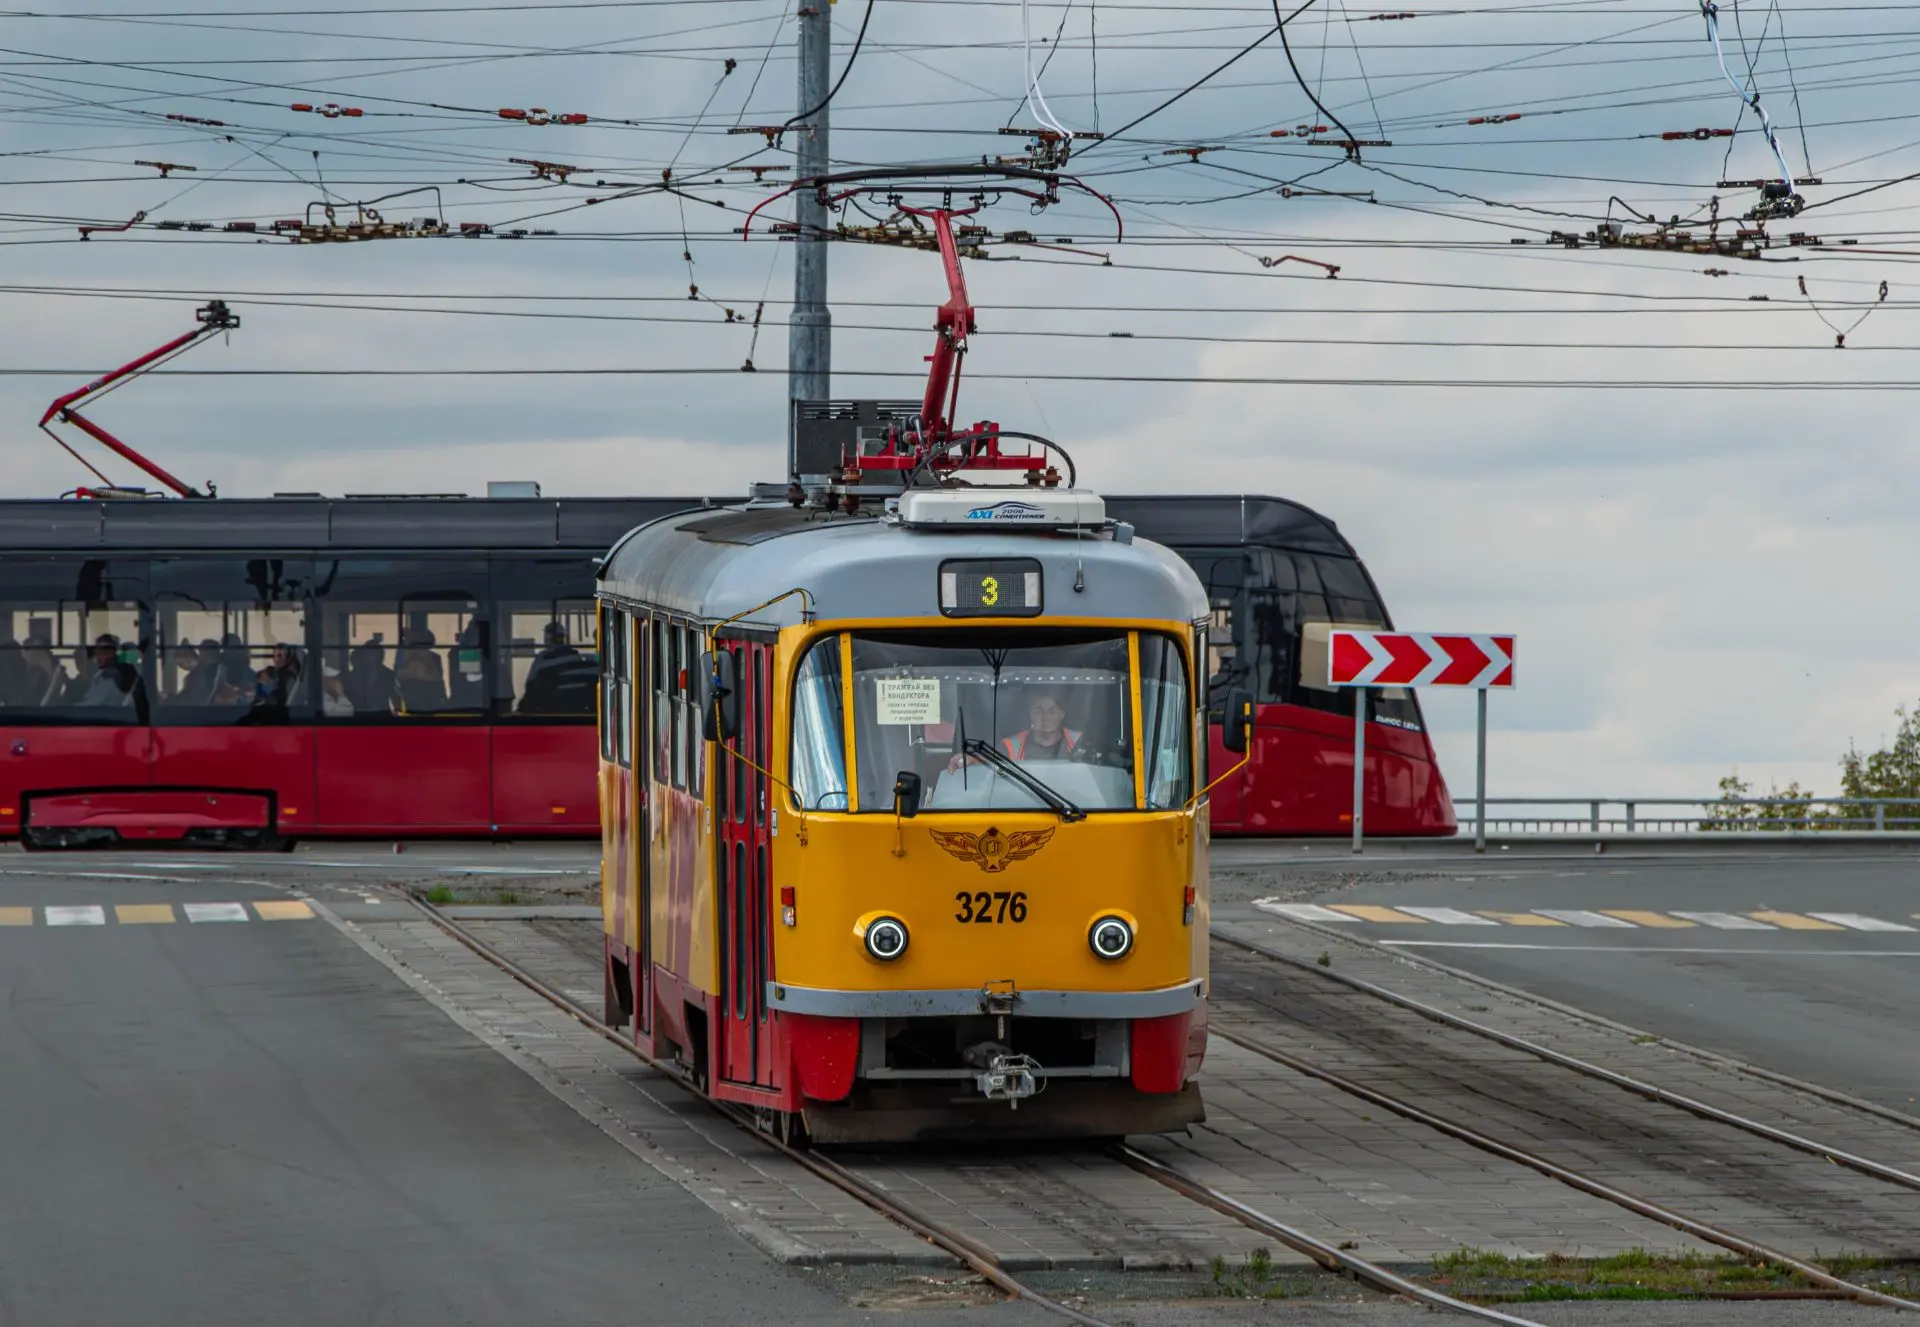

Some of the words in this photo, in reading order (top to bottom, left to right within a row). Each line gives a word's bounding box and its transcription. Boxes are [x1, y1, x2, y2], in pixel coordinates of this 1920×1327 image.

[968, 510, 994, 519] AXI
[982, 576, 998, 606] 3
[955, 891, 1028, 924] 3276
